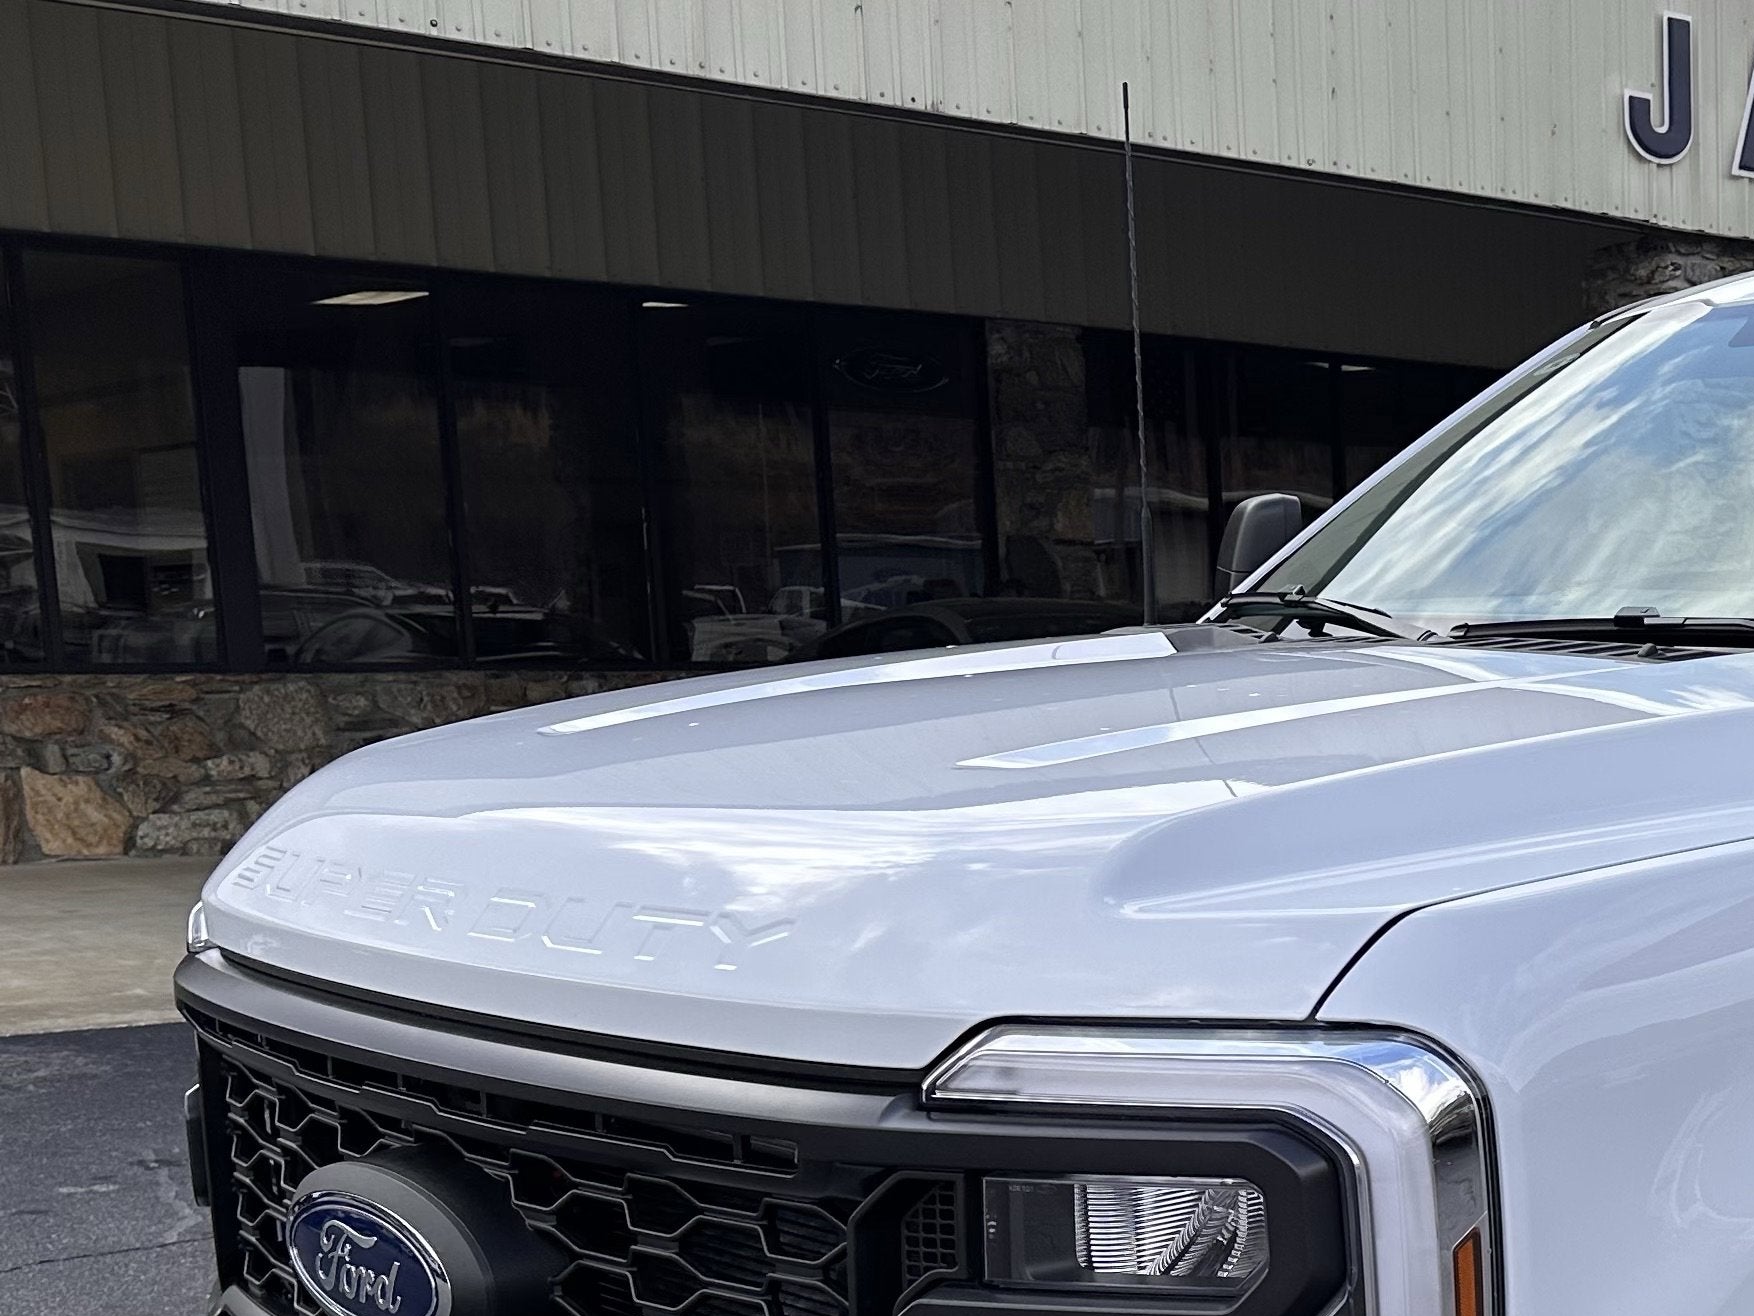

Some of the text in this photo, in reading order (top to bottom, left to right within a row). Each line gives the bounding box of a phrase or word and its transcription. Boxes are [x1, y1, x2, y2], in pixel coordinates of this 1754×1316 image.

[230, 846, 796, 970] SUPER DUTY
[315, 1219, 401, 1313] Ford
